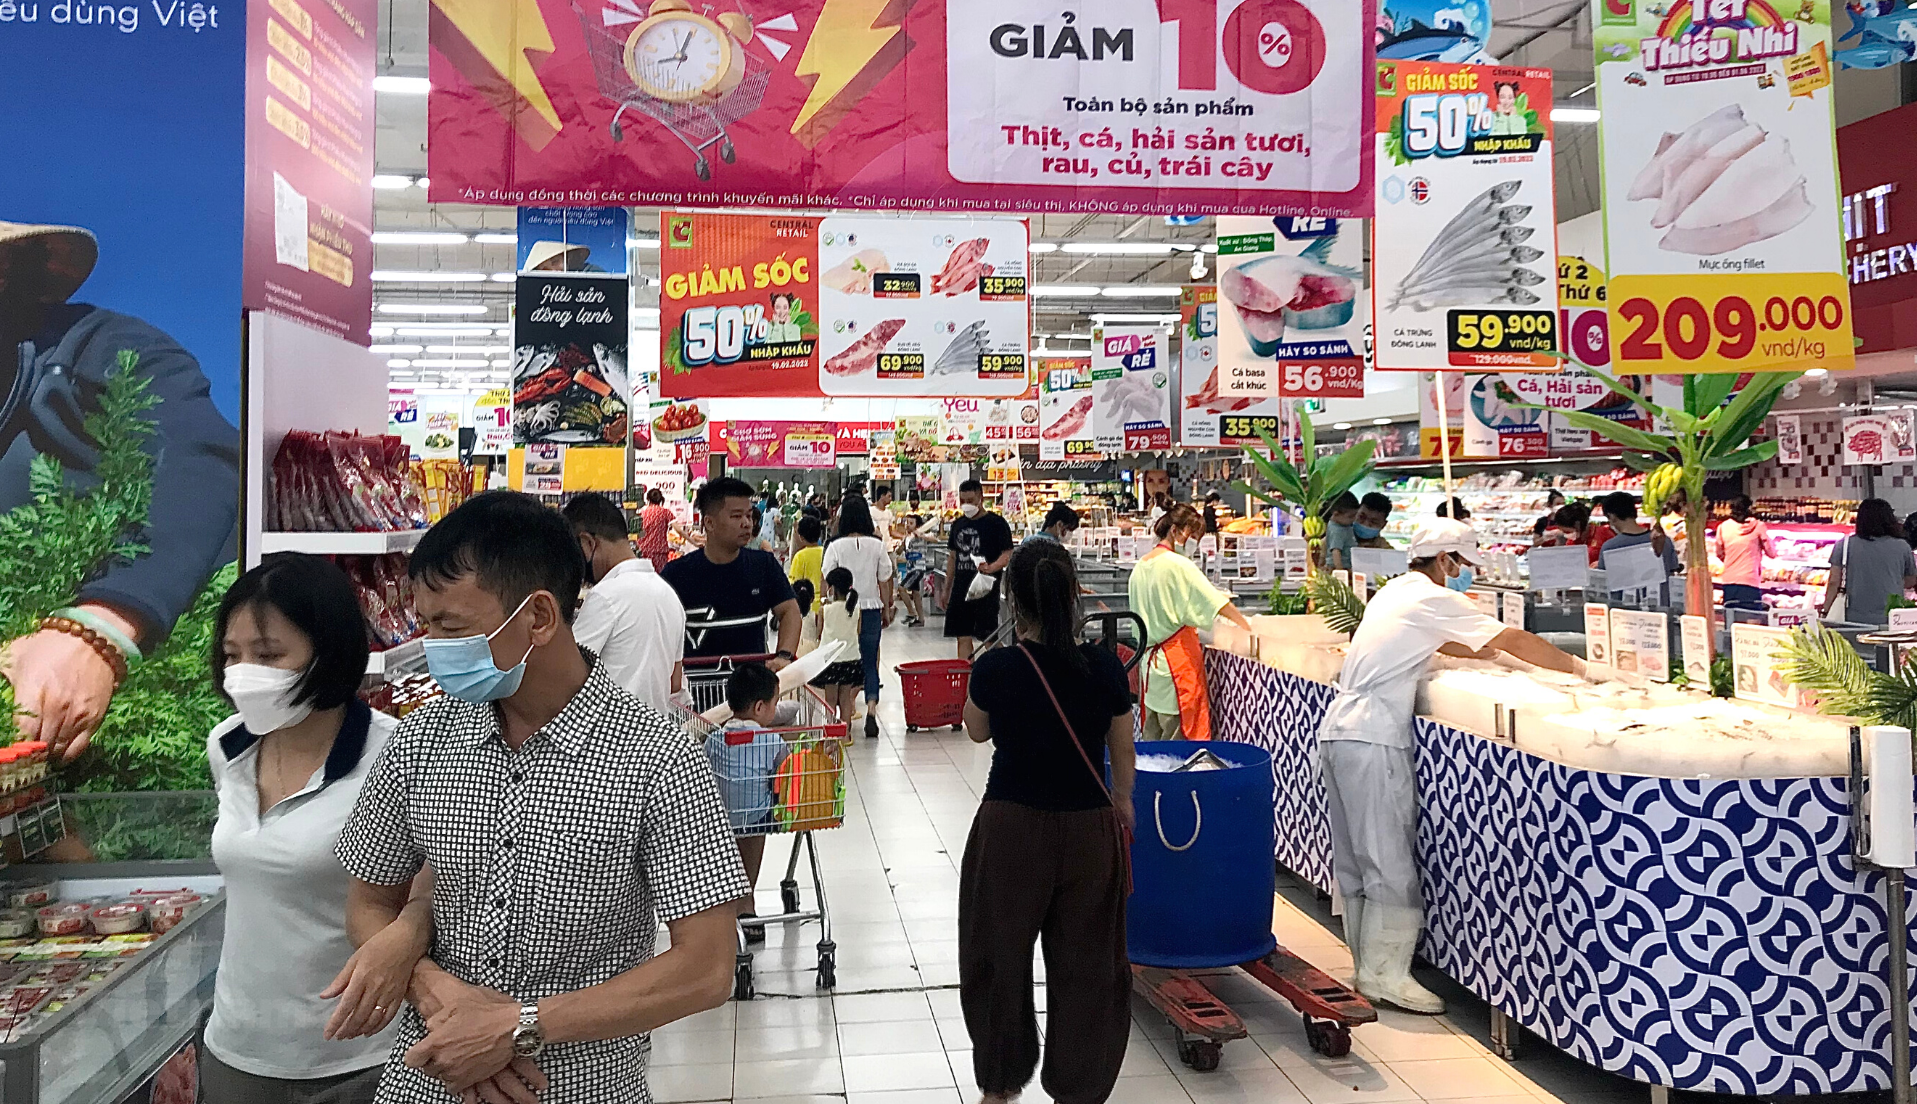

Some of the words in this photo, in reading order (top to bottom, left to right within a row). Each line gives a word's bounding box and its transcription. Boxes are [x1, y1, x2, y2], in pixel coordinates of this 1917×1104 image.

[153, 0, 219, 33] Việt
[989, 12, 1134, 61] GIẢM
[1643, 27, 1731, 69] Thiếu
[1738, 22, 1797, 59] Nhi
[1406, 67, 1445, 91] GIẢM
[1449, 66, 1479, 90] SỐC
[1063, 97, 1114, 114] Toàn
[1120, 98, 1148, 116] bộ
[1153, 100, 1192, 116] sản
[1195, 99, 1255, 118] phẩm
[1405, 94, 1493, 155] 50%
[1001, 125, 1070, 152] Thịt,
[1078, 126, 1123, 152] cá,
[1131, 127, 1176, 150] hải
[1184, 128, 1236, 152] sản
[1245, 132, 1312, 158] tươi,
[1474, 138, 1502, 154] NHẬP
[1503, 135, 1532, 150] KHẨU
[1042, 158, 1099, 178] rau,
[1108, 152, 1152, 180] củ,
[1159, 155, 1211, 178] trái
[1220, 157, 1274, 181] cây
[489, 188, 525, 202] dụng
[528, 188, 564, 202] đồng
[568, 189, 597, 201] thời
[601, 191, 626, 202] các
[629, 191, 682, 204] chương
[687, 192, 719, 203] trình
[723, 192, 774, 205] khuyến
[778, 194, 803, 205] mãi
[880, 197, 897, 208] áp
[900, 196, 934, 209] dụng
[938, 197, 959, 208] khi
[962, 200, 991, 209] mua
[994, 199, 1011, 211] tại
[1014, 199, 1041, 210] siêu
[1044, 200, 1066, 212] thị,
[1068, 198, 1119, 212] KHÔNG
[1121, 201, 1138, 213] áp
[1141, 203, 1174, 215] dụng
[1177, 203, 1198, 213] khi
[1200, 204, 1229, 213] mua
[1232, 205, 1257, 215] qua
[1259, 204, 1308, 217] Hotline,
[770, 219, 814, 229] CENTRAL
[776, 229, 809, 238] RETAIL
[1575, 264, 1588, 280] 2
[1699, 258, 1721, 271] Mực
[1722, 258, 1742, 272] ống
[1743, 258, 1766, 270] fillet
[1847, 242, 1917, 285] HERY
[665, 263, 746, 300] GIẢM
[753, 252, 810, 289] SỐC
[983, 277, 1024, 294] 35.900
[541, 284, 573, 305] Hải
[575, 286, 606, 304] sản
[531, 306, 573, 328] đông
[576, 307, 614, 327] lạnh
[684, 303, 769, 362] 50%
[1393, 327, 1405, 337] CÁ
[1456, 314, 1551, 349] 59.900
[1617, 295, 1844, 361] 209.000
[750, 347, 780, 361] NHẬP
[781, 340, 811, 357] KHẨU
[1107, 336, 1132, 354] GIÁ
[1303, 347, 1317, 356] SO
[1319, 343, 1349, 355] SÁNH
[1391, 339, 1414, 349] ĐÔNG
[1509, 338, 1551, 351] vnd/kg
[1761, 336, 1826, 360] vnd/kg
[880, 355, 922, 372] 69.900
[981, 355, 1023, 372] 59.900
[1130, 349, 1152, 368] RẺ
[1050, 368, 1080, 390] 50%
[1232, 367, 1244, 377] Cá
[1245, 367, 1266, 377] basa
[1283, 365, 1357, 391] 56.900
[1231, 379, 1246, 390] cắt
[1246, 380, 1267, 390] khúc
[1517, 378, 1542, 395] Cá,
[1546, 378, 1572, 394] Hải
[1576, 379, 1603, 395] sản
[1545, 395, 1576, 409] tươi
